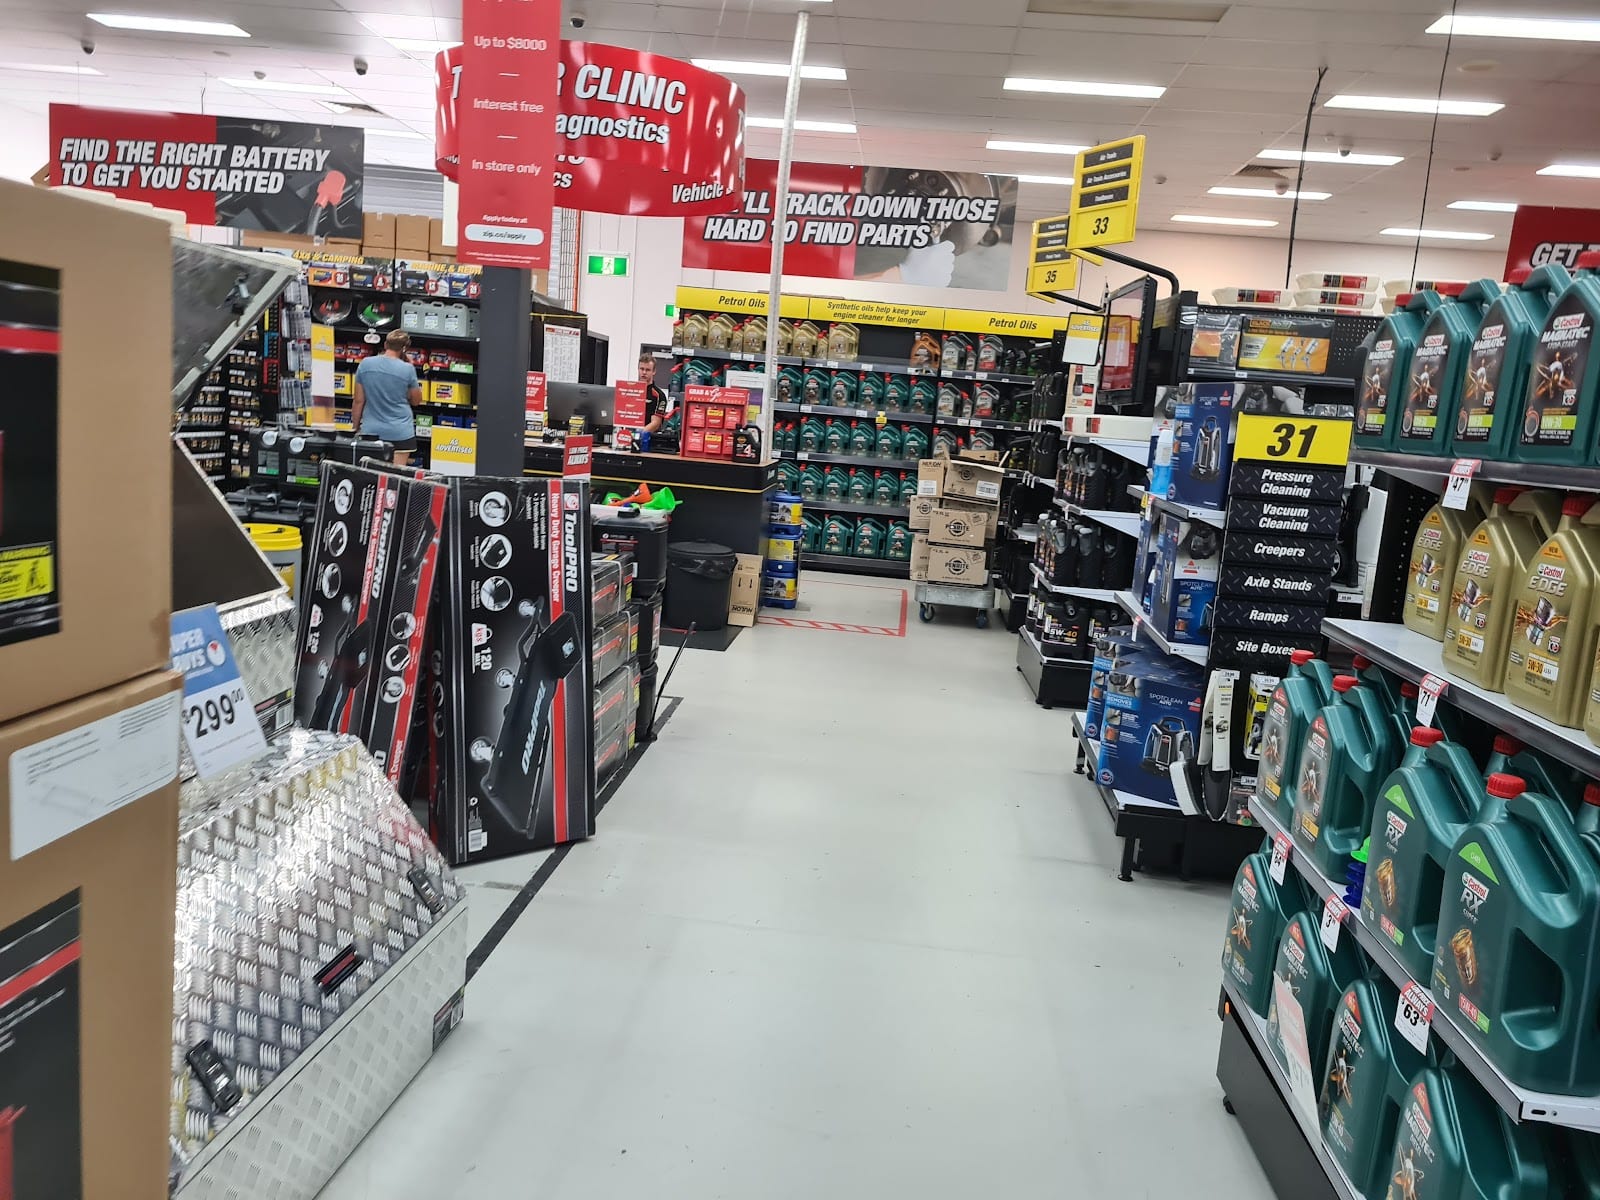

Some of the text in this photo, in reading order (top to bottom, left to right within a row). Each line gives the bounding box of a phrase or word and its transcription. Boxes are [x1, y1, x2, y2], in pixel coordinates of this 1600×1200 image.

[473, 35, 548, 51] Up to $8000
[574, 64, 686, 115] CLINIC
[473, 98, 544, 113] Interest free
[59, 138, 330, 172] FIND THE RIGHT BATTERY
[471, 159, 541, 176] In store only
[61, 162, 285, 195] TO GET YOU STARTED
[672, 181, 723, 203] Vehicle
[851, 195, 924, 219] DOWN
[924, 197, 1000, 222] THOSE
[704, 217, 767, 243] HARD
[801, 222, 855, 246] FIND
[857, 223, 932, 248] PARTS
[1092, 217, 1109, 235] 33
[321, 253, 364, 265] CAMPING
[1531, 242, 1583, 267] GET
[1044, 270, 1058, 284] 35
[718, 295, 766, 308] Petrol Oils
[826, 301, 927, 318] Synthetic oils help keep your
[833, 311, 920, 326] engine cleaner for longer
[988, 317, 1038, 330] Petrol Oils
[1541, 327, 1590, 342] MAGNATEC
[435, 442, 473, 455] ADVERTISED
[1266, 422, 1318, 459] 31
[1261, 469, 1315, 484] Pressure
[1260, 482, 1311, 498] Cleaning
[1262, 504, 1309, 518] Vacuum
[1258, 517, 1309, 532] Cleaning
[550, 492, 560, 603] Heavy Duty Garage Creeper
[564, 511, 578, 593] ToolPRO
[1254, 542, 1306, 557] Creepers
[1416, 536, 1443, 551] EDGE
[1460, 560, 1491, 577] EDGE
[1543, 566, 1563, 579] Castrol
[1244, 575, 1313, 592] Axle Stands
[1528, 575, 1567, 597] EDGE
[1249, 609, 1290, 624] Ramps
[1050, 628, 1078, 638] 5W-40
[1235, 640, 1296, 657] Site Boxes
[480, 646, 493, 671] 120
[1527, 661, 1543, 675] 5W-30
[1384, 824, 1404, 847] RX
[1467, 878, 1487, 898] Castrol
[1460, 887, 1484, 916] RX
[1403, 988, 1428, 1017] ALWAYS
